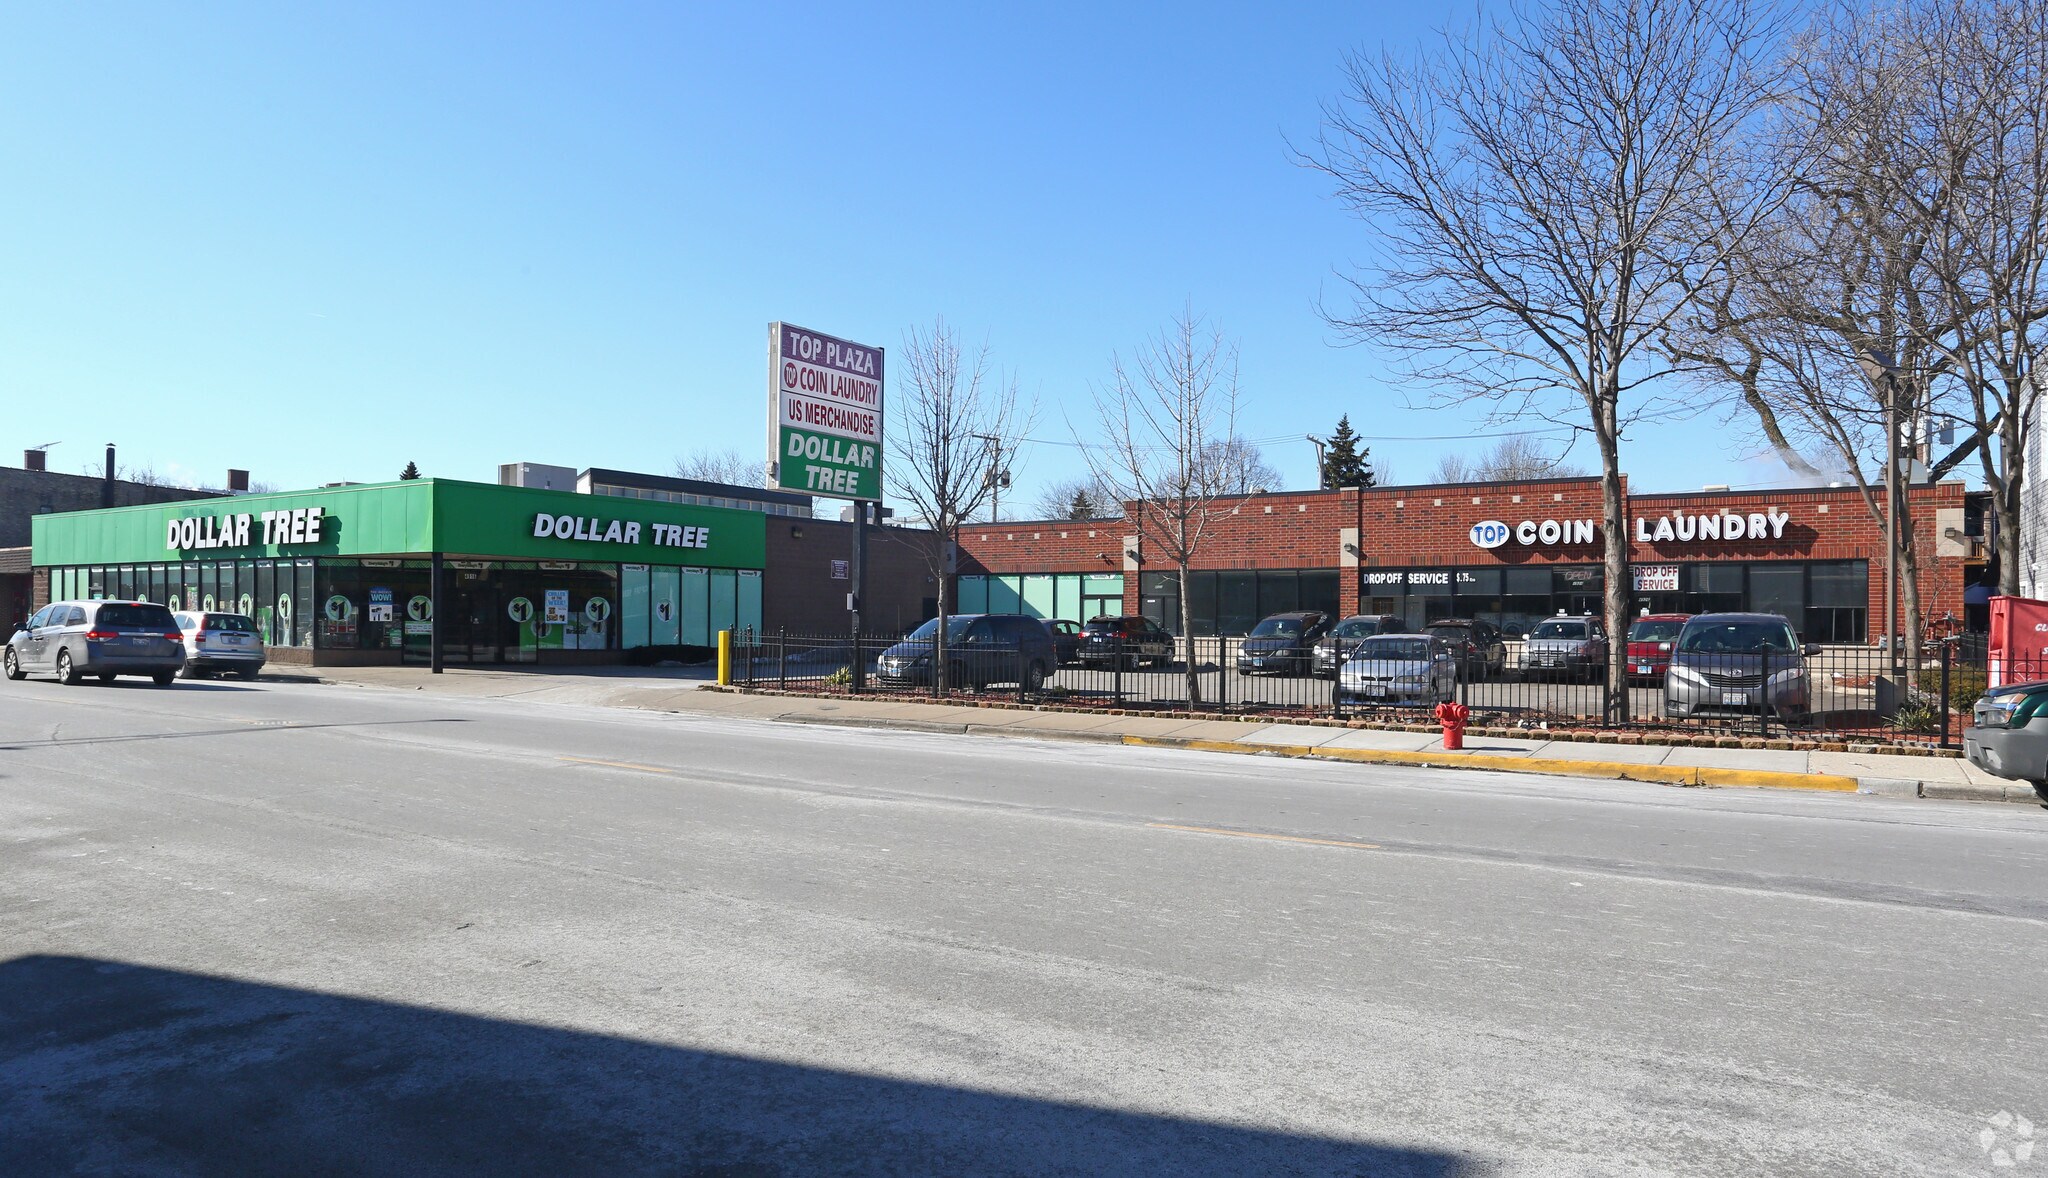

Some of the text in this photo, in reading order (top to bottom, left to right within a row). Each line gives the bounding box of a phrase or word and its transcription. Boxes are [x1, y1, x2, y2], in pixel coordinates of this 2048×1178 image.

[790, 332, 874, 375] TOP PLAZA
[786, 366, 877, 405] TOP COIN LAUNDRY
[789, 398, 874, 435] US MERCHANDISE
[787, 432, 875, 468] DOLLAR
[805, 464, 859, 494] TREE
[166, 507, 323, 550] DOLLAR TREE
[534, 513, 710, 549] DOLLAR TREE
[1473, 512, 1789, 546] TOP COIN LAUNDRY
[1363, 573, 1386, 584] DROP
[1387, 573, 1403, 584] OFF
[1408, 573, 1449, 584] SERVICE
[1634, 566, 1678, 577] DROP OFF
[1637, 579, 1674, 590] SERVICE
[371, 593, 392, 601] WOW!
[331, 602, 345, 620] $1
[413, 602, 427, 620] $1
[513, 602, 527, 621] $1
[591, 602, 604, 621] $1
[660, 603, 670, 621] $1
